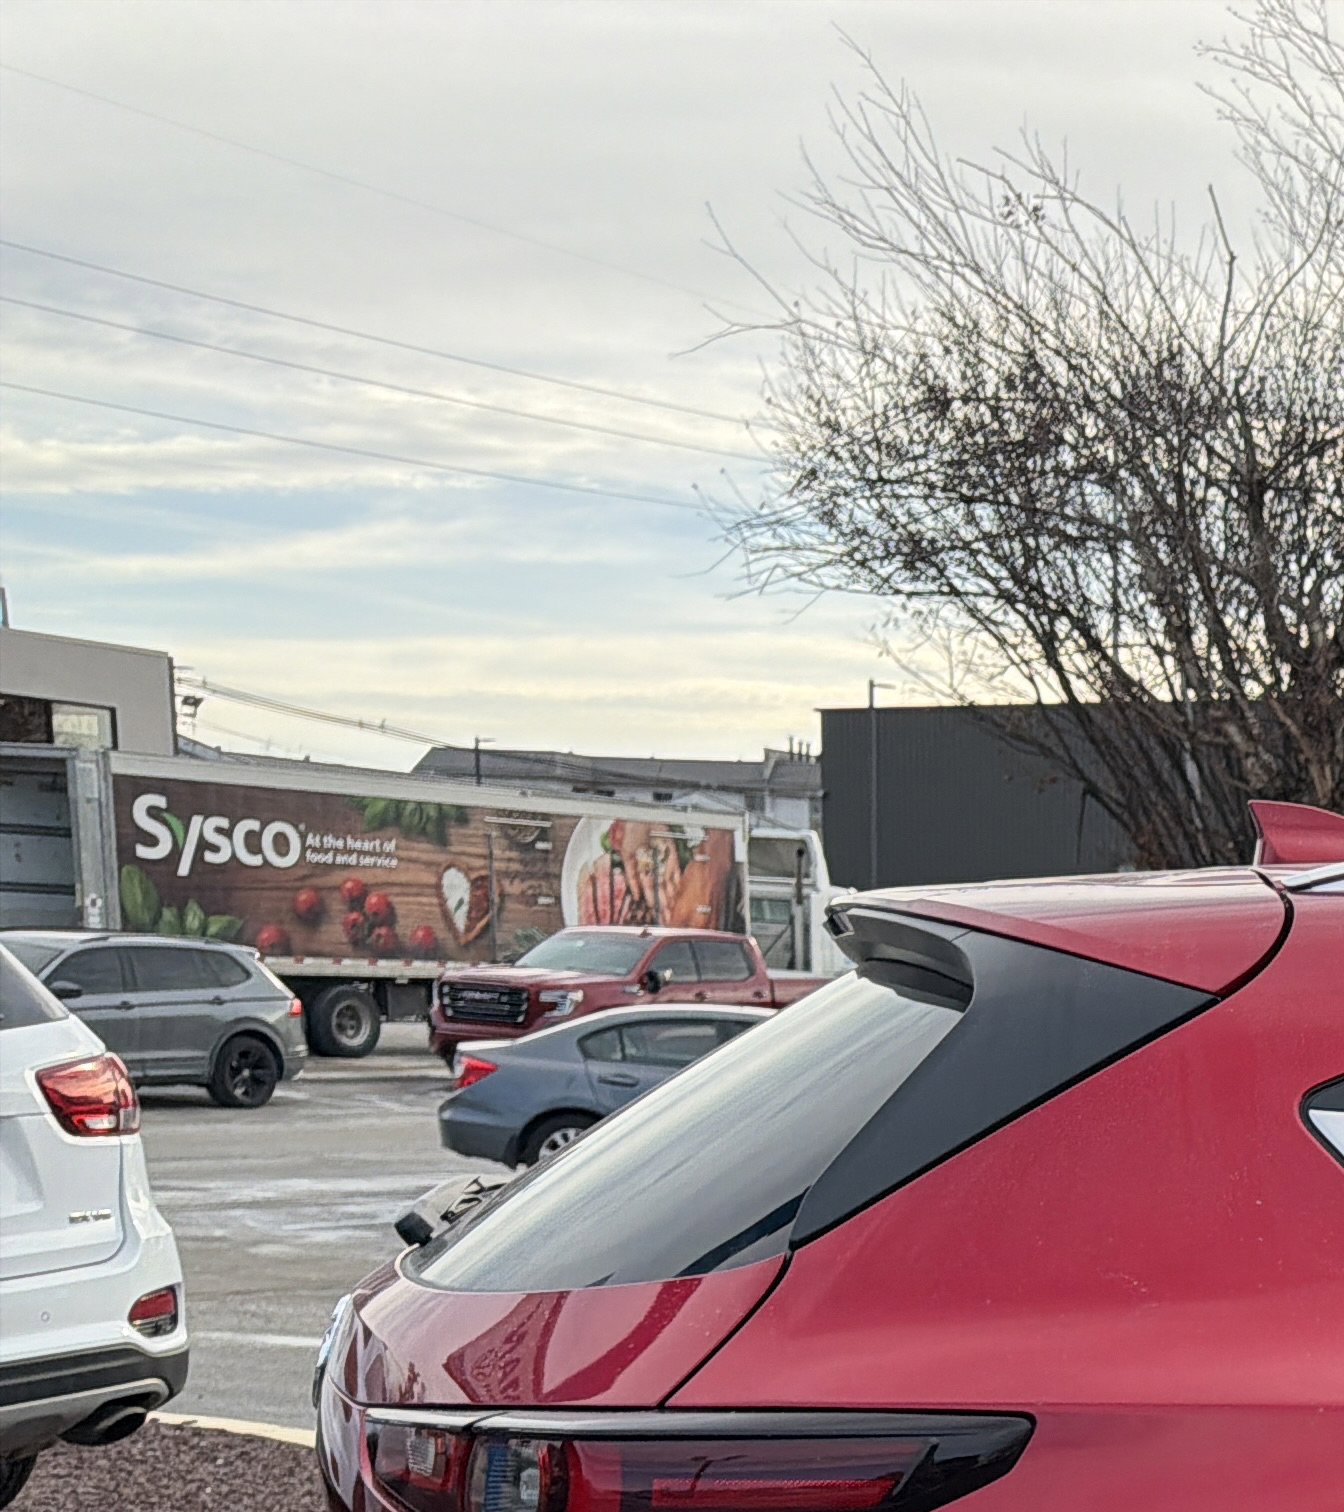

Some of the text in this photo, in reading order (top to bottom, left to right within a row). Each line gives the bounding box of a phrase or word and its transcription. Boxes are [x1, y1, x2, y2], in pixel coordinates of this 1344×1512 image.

[306, 833, 397, 852] At the heart of
[306, 849, 398, 868] food and service
